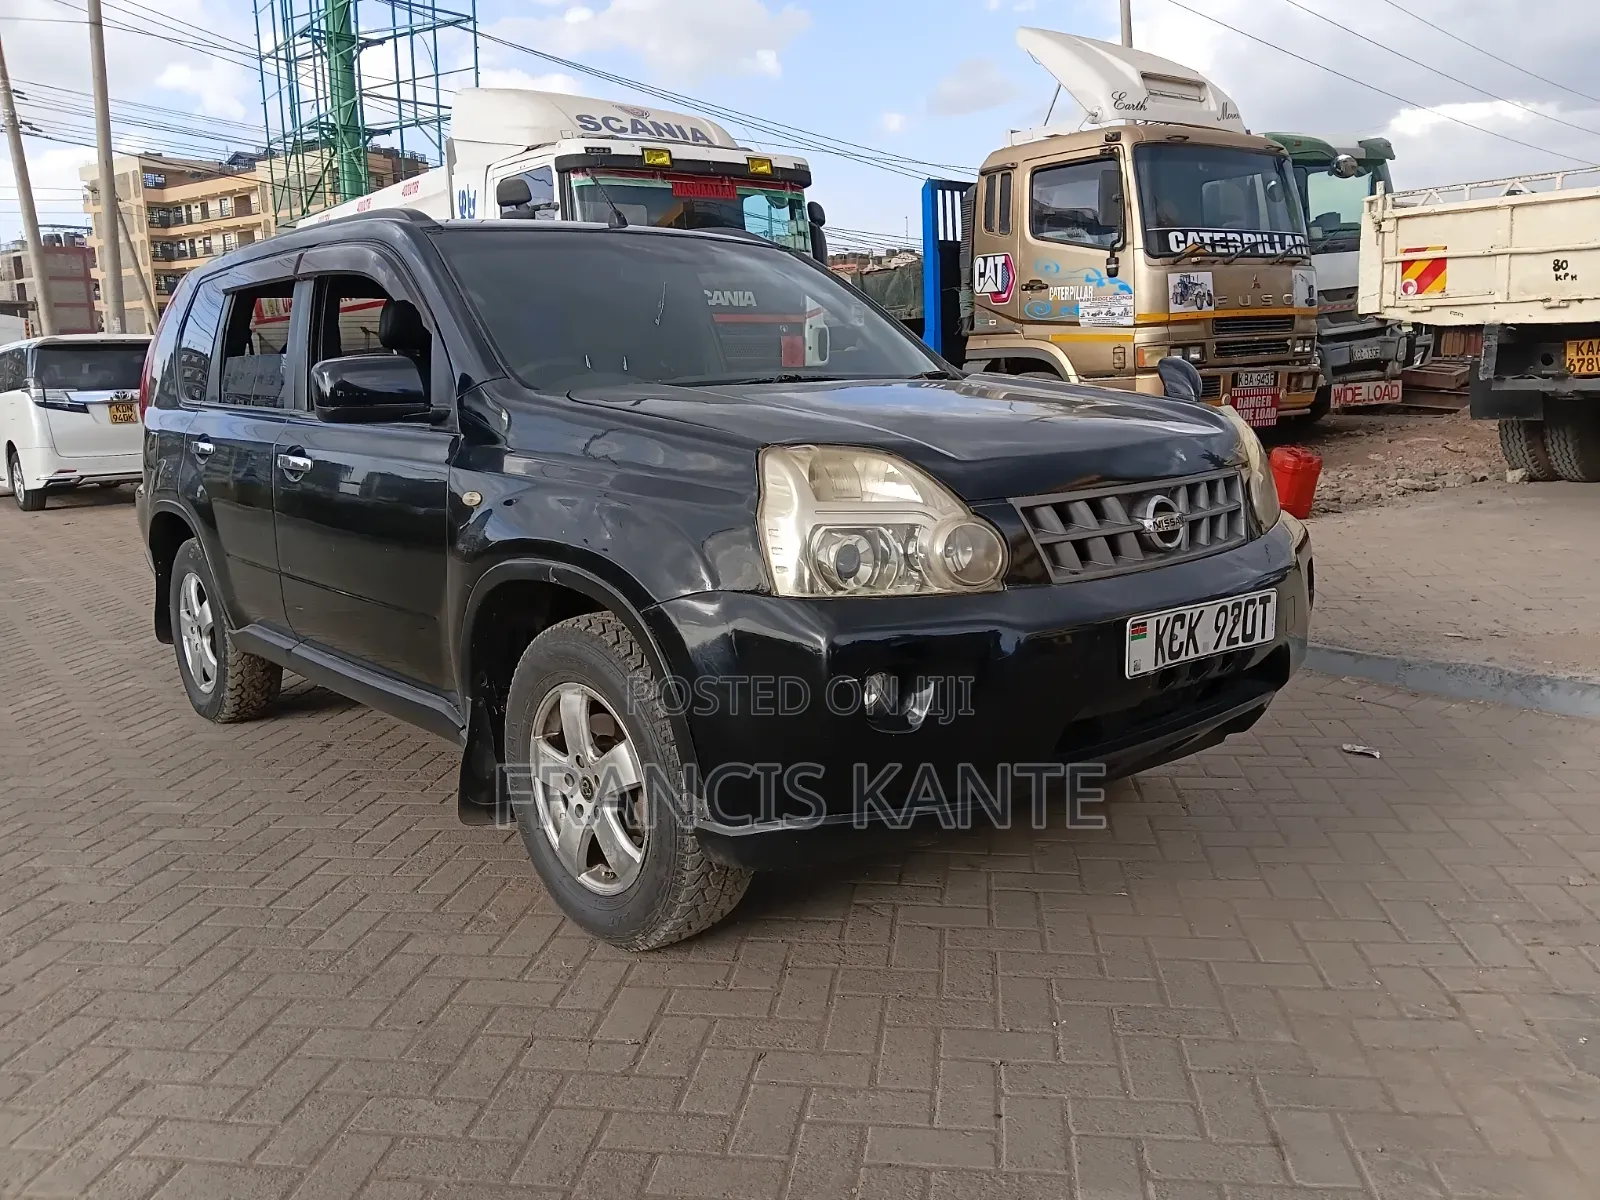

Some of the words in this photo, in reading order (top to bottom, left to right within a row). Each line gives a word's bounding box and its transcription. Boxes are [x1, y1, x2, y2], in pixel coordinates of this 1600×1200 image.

[1111, 91, 1149, 112] Earth
[575, 114, 716, 145] SCANIA
[1168, 231, 1307, 255] CATERPILLAR
[974, 255, 1006, 293] CAT
[1552, 259, 1569, 271] 80
[1050, 286, 1094, 300] CATERPILLAR
[1237, 395, 1272, 410] DANGER
[1255, 407, 1277, 419] LOAD
[1152, 513, 1185, 531] NISSAN
[1154, 610, 1205, 667] KCK
[1213, 594, 1272, 651] 920T
